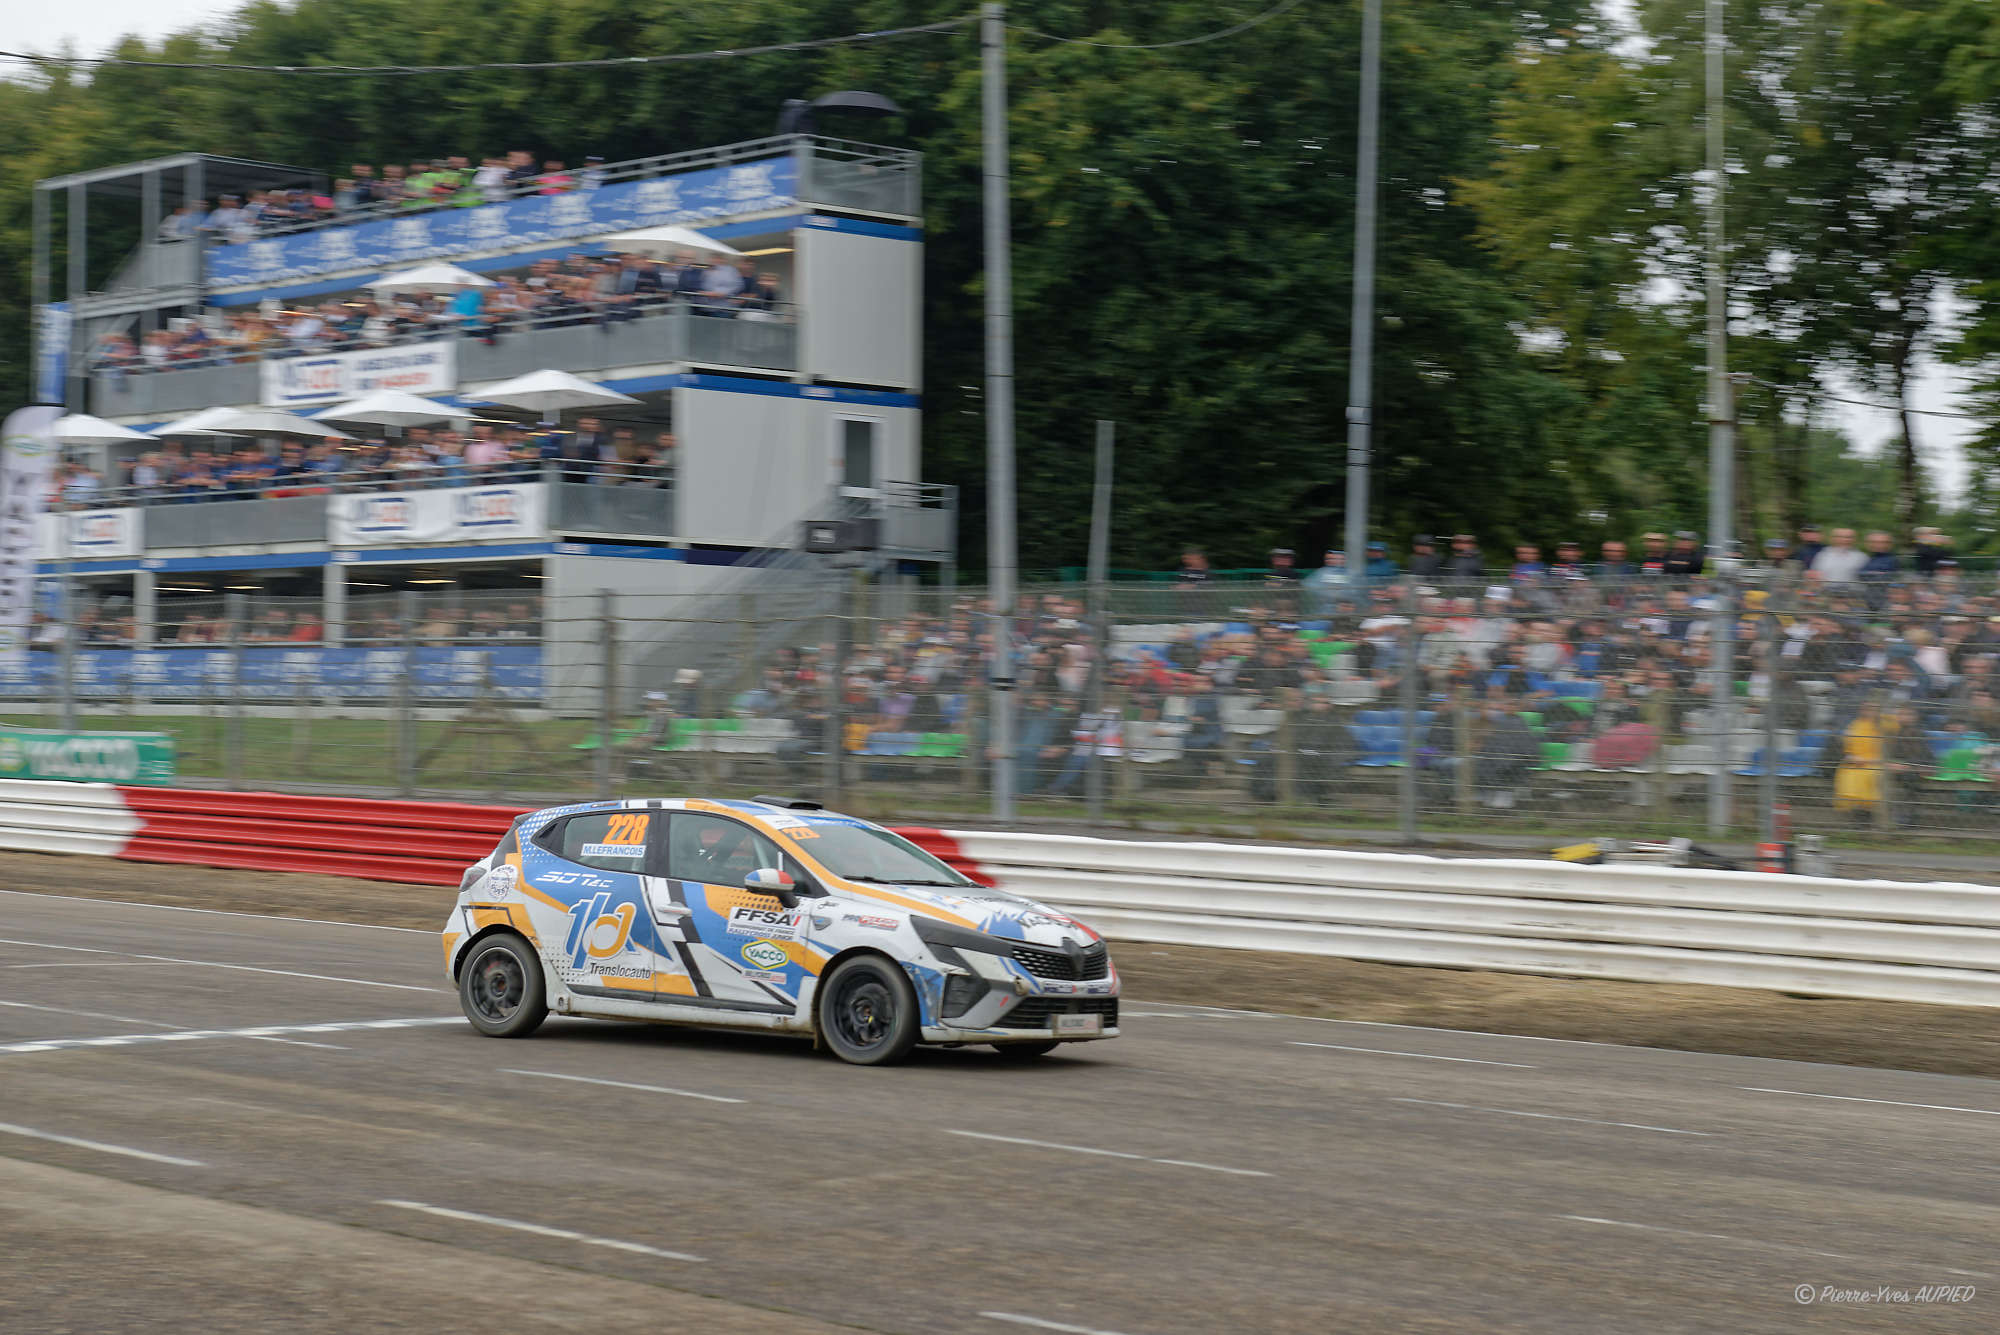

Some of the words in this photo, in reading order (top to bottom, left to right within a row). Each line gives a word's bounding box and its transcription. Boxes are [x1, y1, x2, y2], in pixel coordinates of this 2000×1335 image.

[602, 813, 650, 845] 228
[734, 908, 791, 926] FFSA
[747, 947, 784, 961] YACCO
[590, 962, 652, 979] Translocauto
